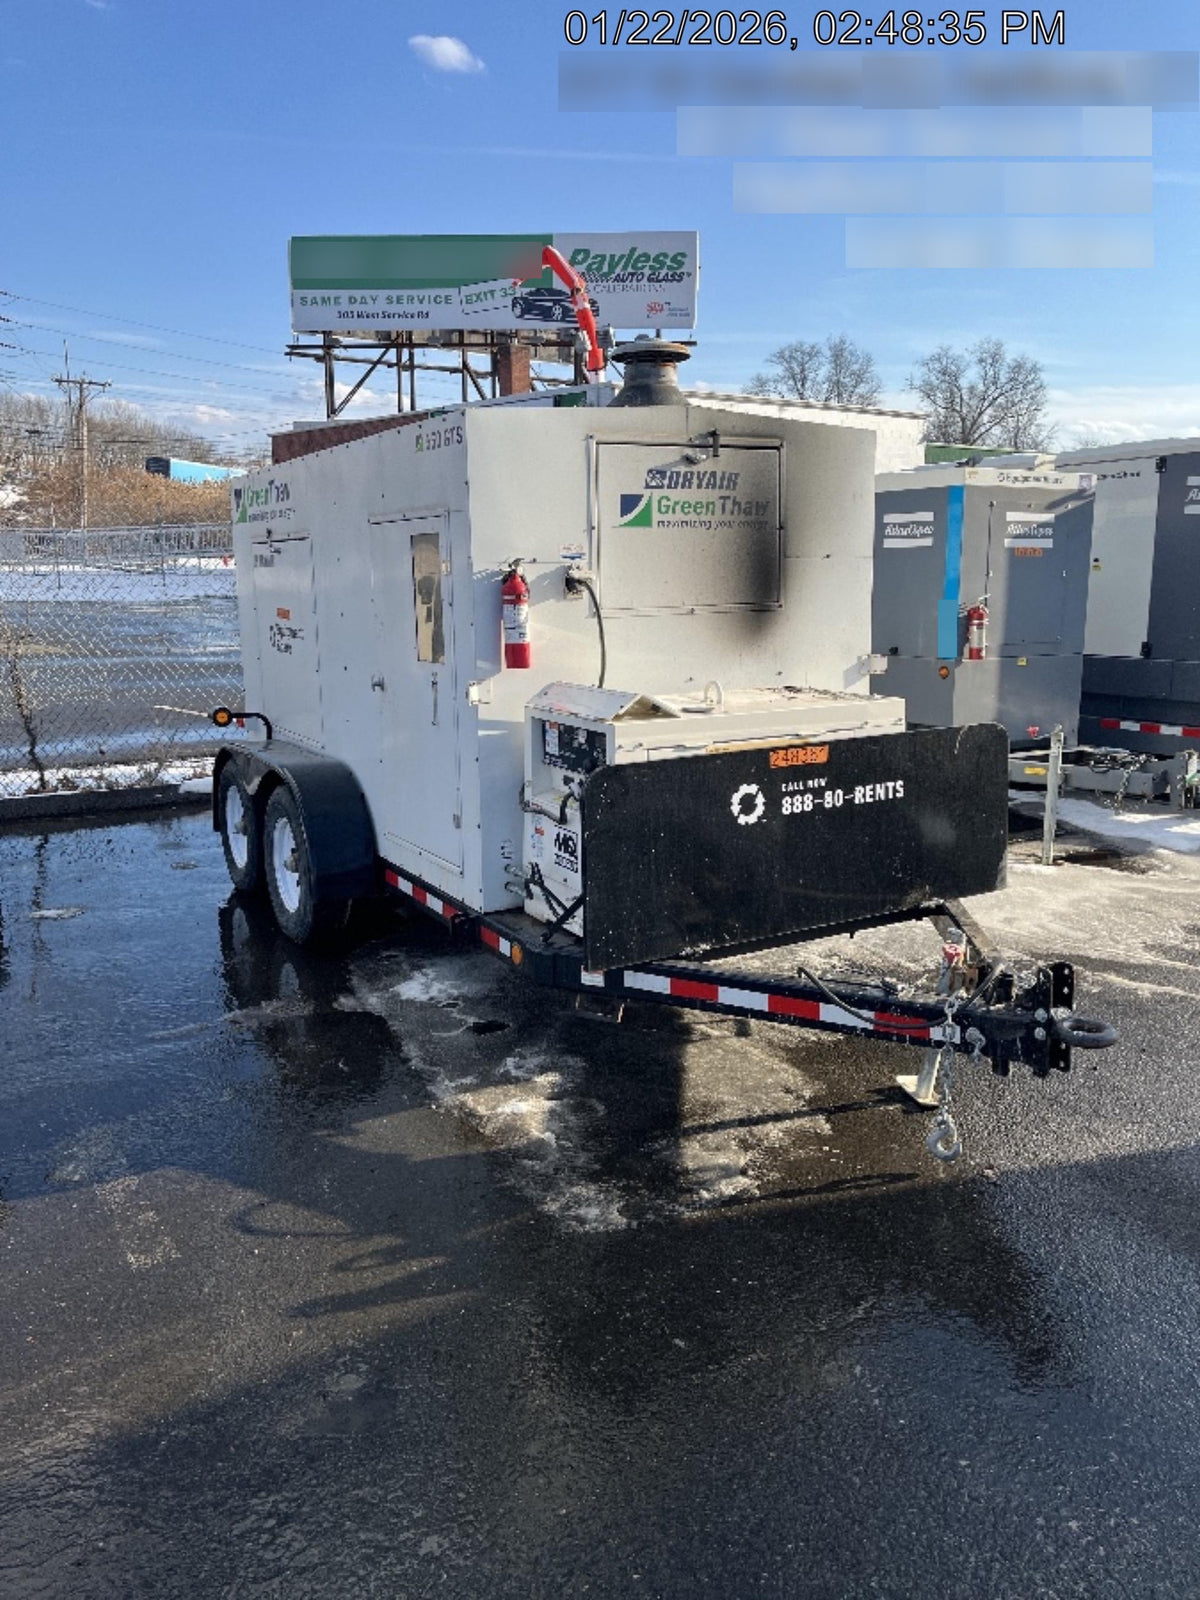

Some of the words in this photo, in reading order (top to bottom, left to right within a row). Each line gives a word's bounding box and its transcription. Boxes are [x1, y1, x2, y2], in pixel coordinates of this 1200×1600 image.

[568, 246, 687, 279] Payless
[611, 271, 645, 283] AUTO
[646, 271, 686, 283] GLASS
[299, 295, 342, 306] SAME
[347, 295, 379, 305] DAY
[385, 294, 453, 305] SERVICE
[464, 289, 497, 305] EXIT
[380, 310, 415, 319] Service
[416, 310, 430, 319] Rd
[667, 470, 740, 490] DRYAIR
[781, 781, 804, 792] CALL
[781, 780, 905, 816] 888-80-RENTS
